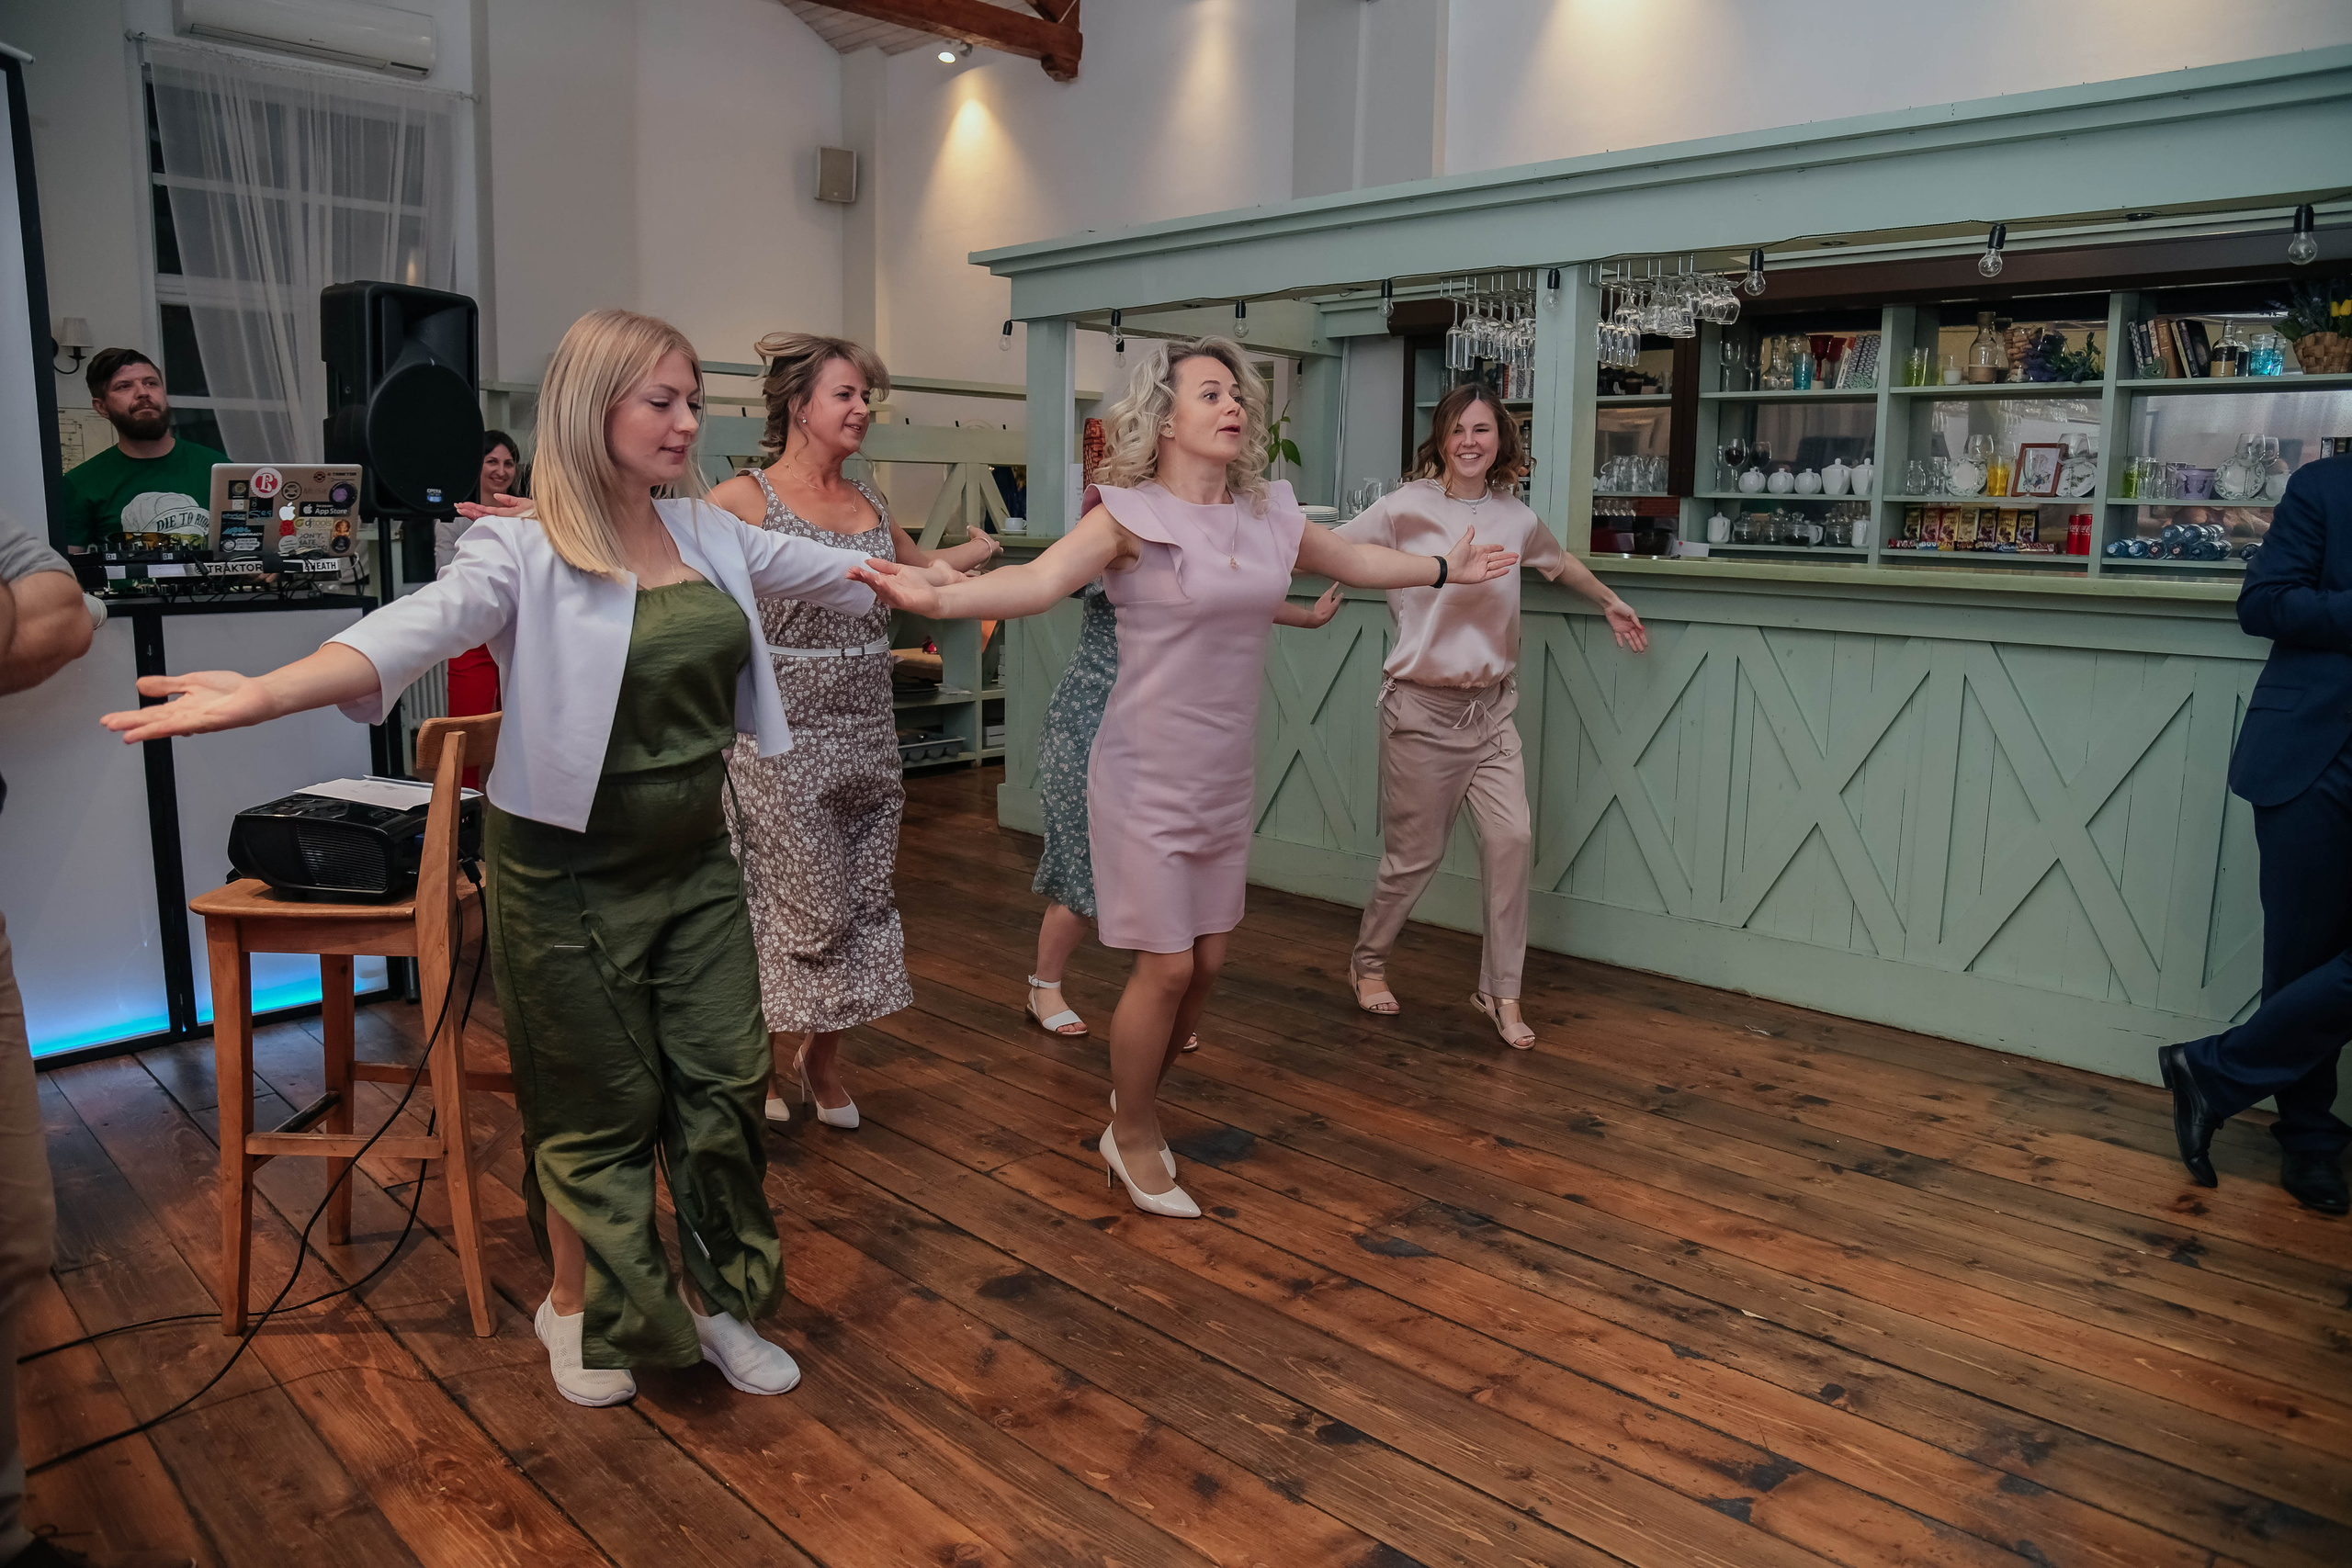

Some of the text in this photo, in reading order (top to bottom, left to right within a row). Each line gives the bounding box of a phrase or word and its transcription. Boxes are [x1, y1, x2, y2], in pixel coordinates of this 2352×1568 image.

[156, 515, 176, 531] DIE
[179, 512, 194, 525] TO
[207, 563, 263, 573] TRAKTOR
